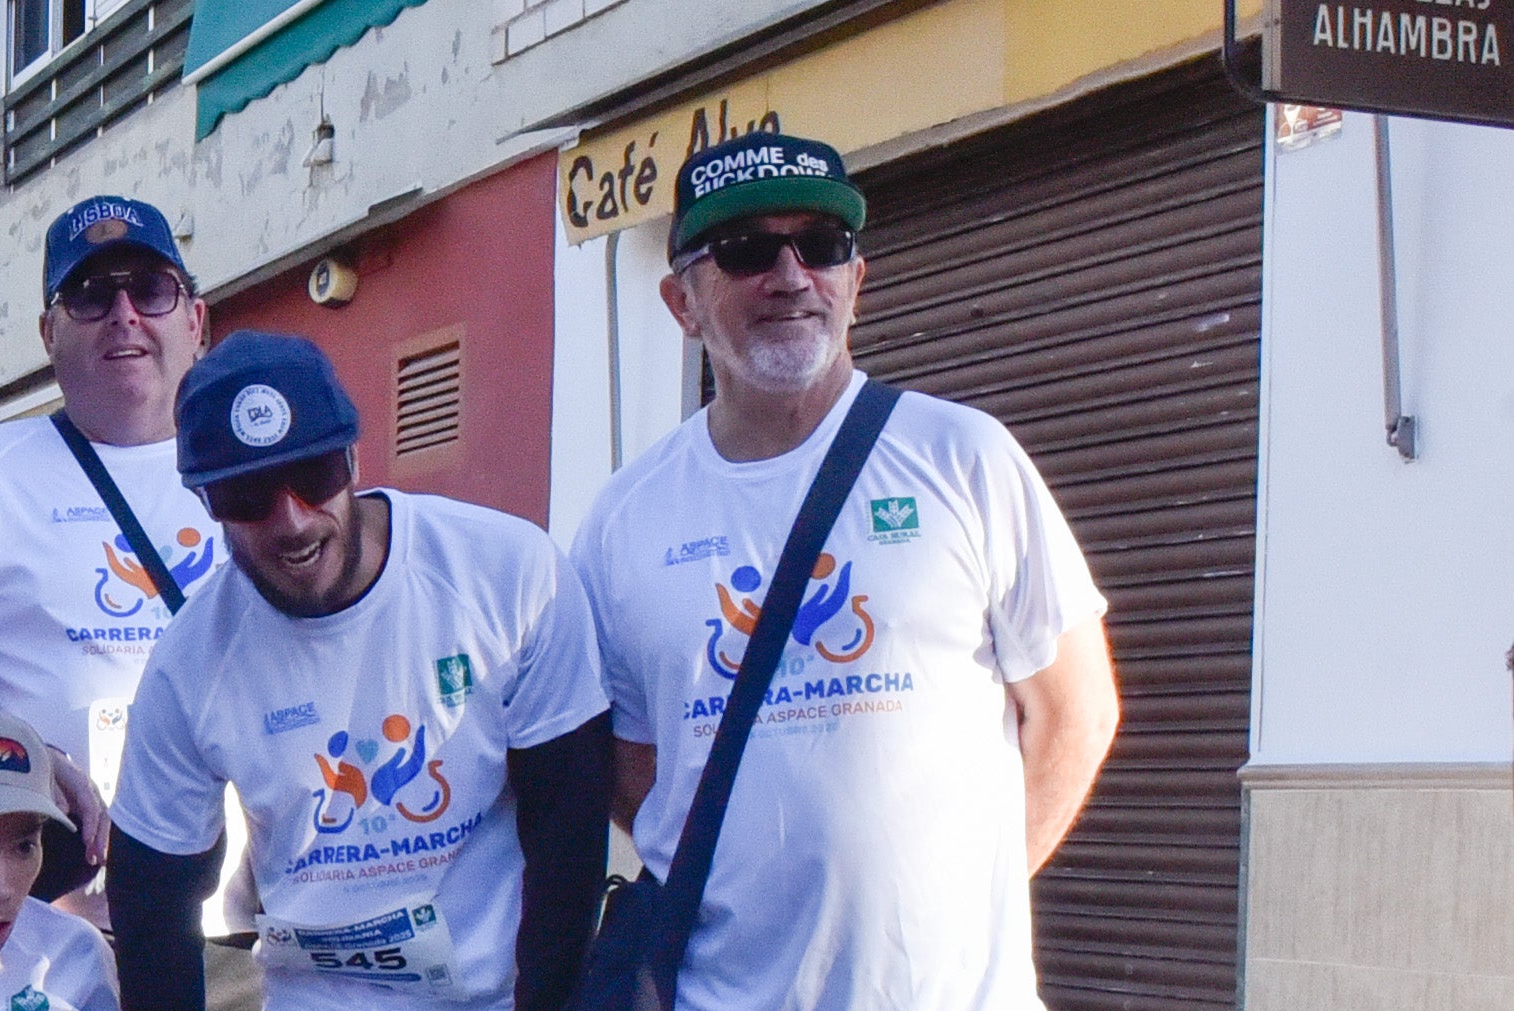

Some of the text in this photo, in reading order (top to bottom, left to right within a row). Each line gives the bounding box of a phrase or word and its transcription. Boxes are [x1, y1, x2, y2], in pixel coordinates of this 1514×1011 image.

[1313, 3, 1501, 66] ALHAMBRA
[567, 131, 657, 228] Café
[691, 147, 829, 186] COMME des
[69, 201, 145, 242] LISBOA
[767, 705, 827, 724] ASPACE
[358, 860, 416, 879] ASPACE
[310, 947, 408, 970] 545
